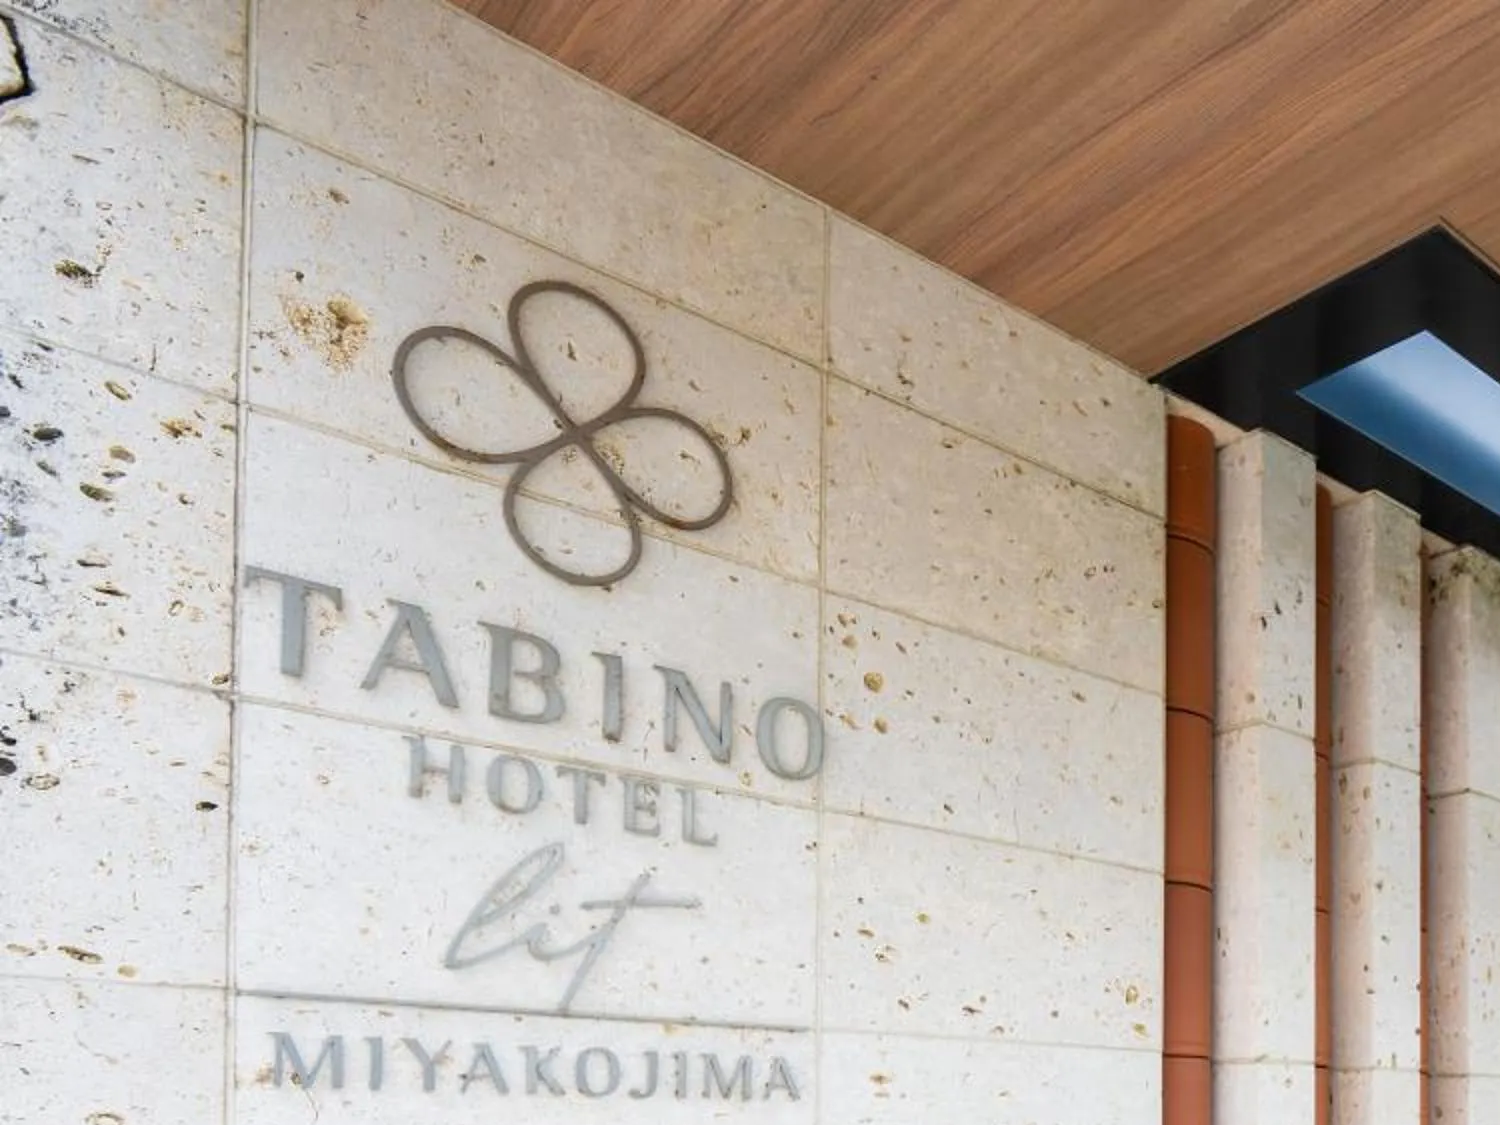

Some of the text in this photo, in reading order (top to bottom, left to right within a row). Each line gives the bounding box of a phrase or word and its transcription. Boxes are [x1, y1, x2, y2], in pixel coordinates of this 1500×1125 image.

[244, 564, 825, 781] TABINO
[402, 734, 718, 847] HOTEL
[268, 1031, 802, 1101] MIYAKOJIMA
